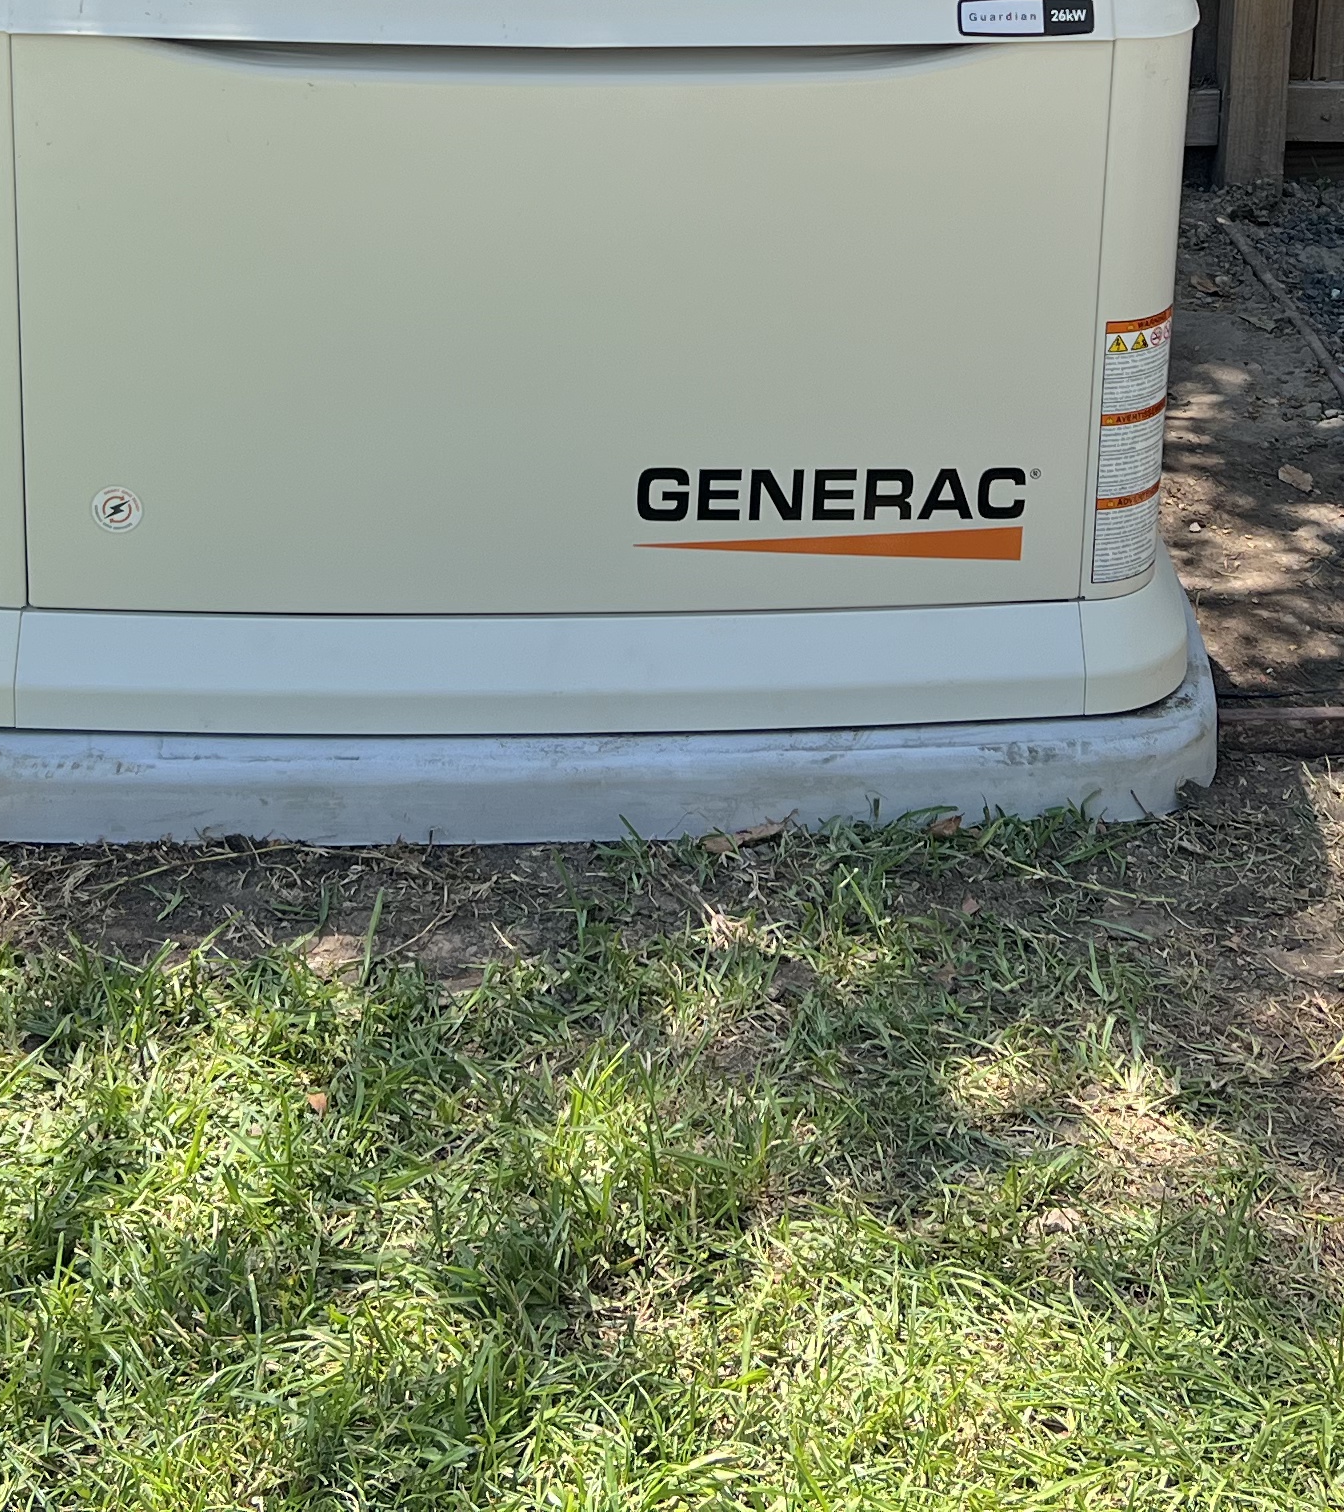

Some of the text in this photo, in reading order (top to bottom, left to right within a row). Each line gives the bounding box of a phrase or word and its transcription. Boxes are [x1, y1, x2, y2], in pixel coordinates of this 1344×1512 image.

[968, 9, 1086, 22] Guardian 26kW
[636, 467, 1026, 521] GENERAC
